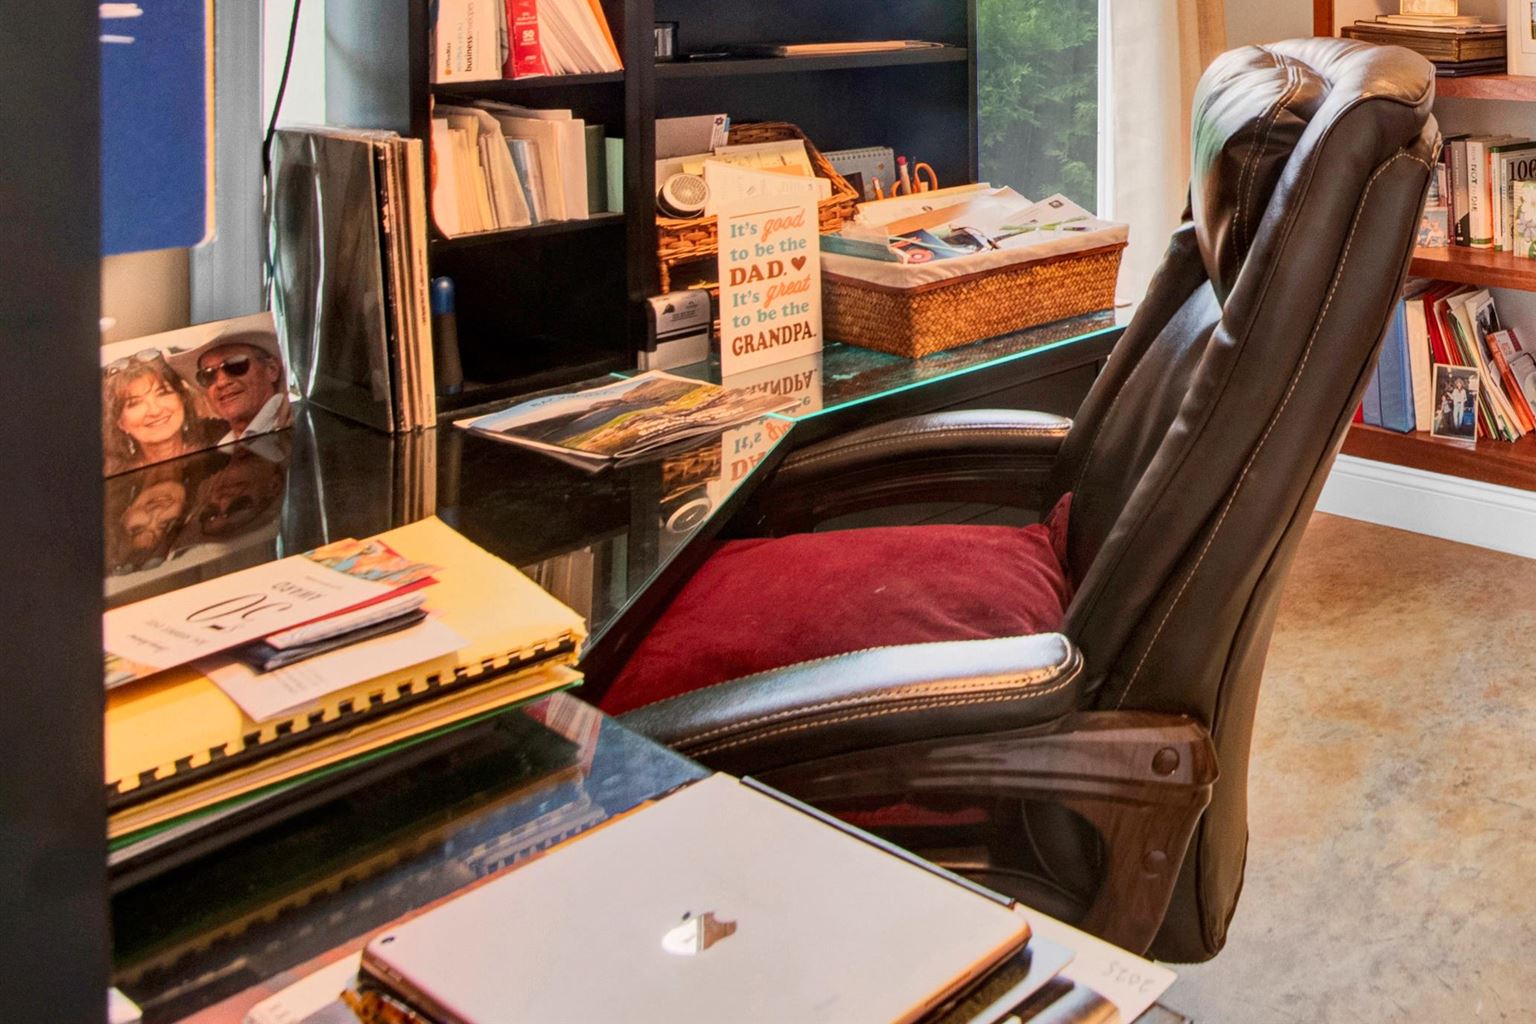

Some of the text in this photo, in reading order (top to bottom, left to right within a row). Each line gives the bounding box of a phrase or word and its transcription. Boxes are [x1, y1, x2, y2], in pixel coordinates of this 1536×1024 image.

[730, 208, 806, 243] It's good
[730, 237, 807, 262] to be the
[729, 260, 788, 287] DAD.
[732, 275, 811, 309] It's great
[732, 302, 809, 329] to be the
[732, 320, 817, 357] GRANDPA.
[1101, 959, 1156, 994] 2025
